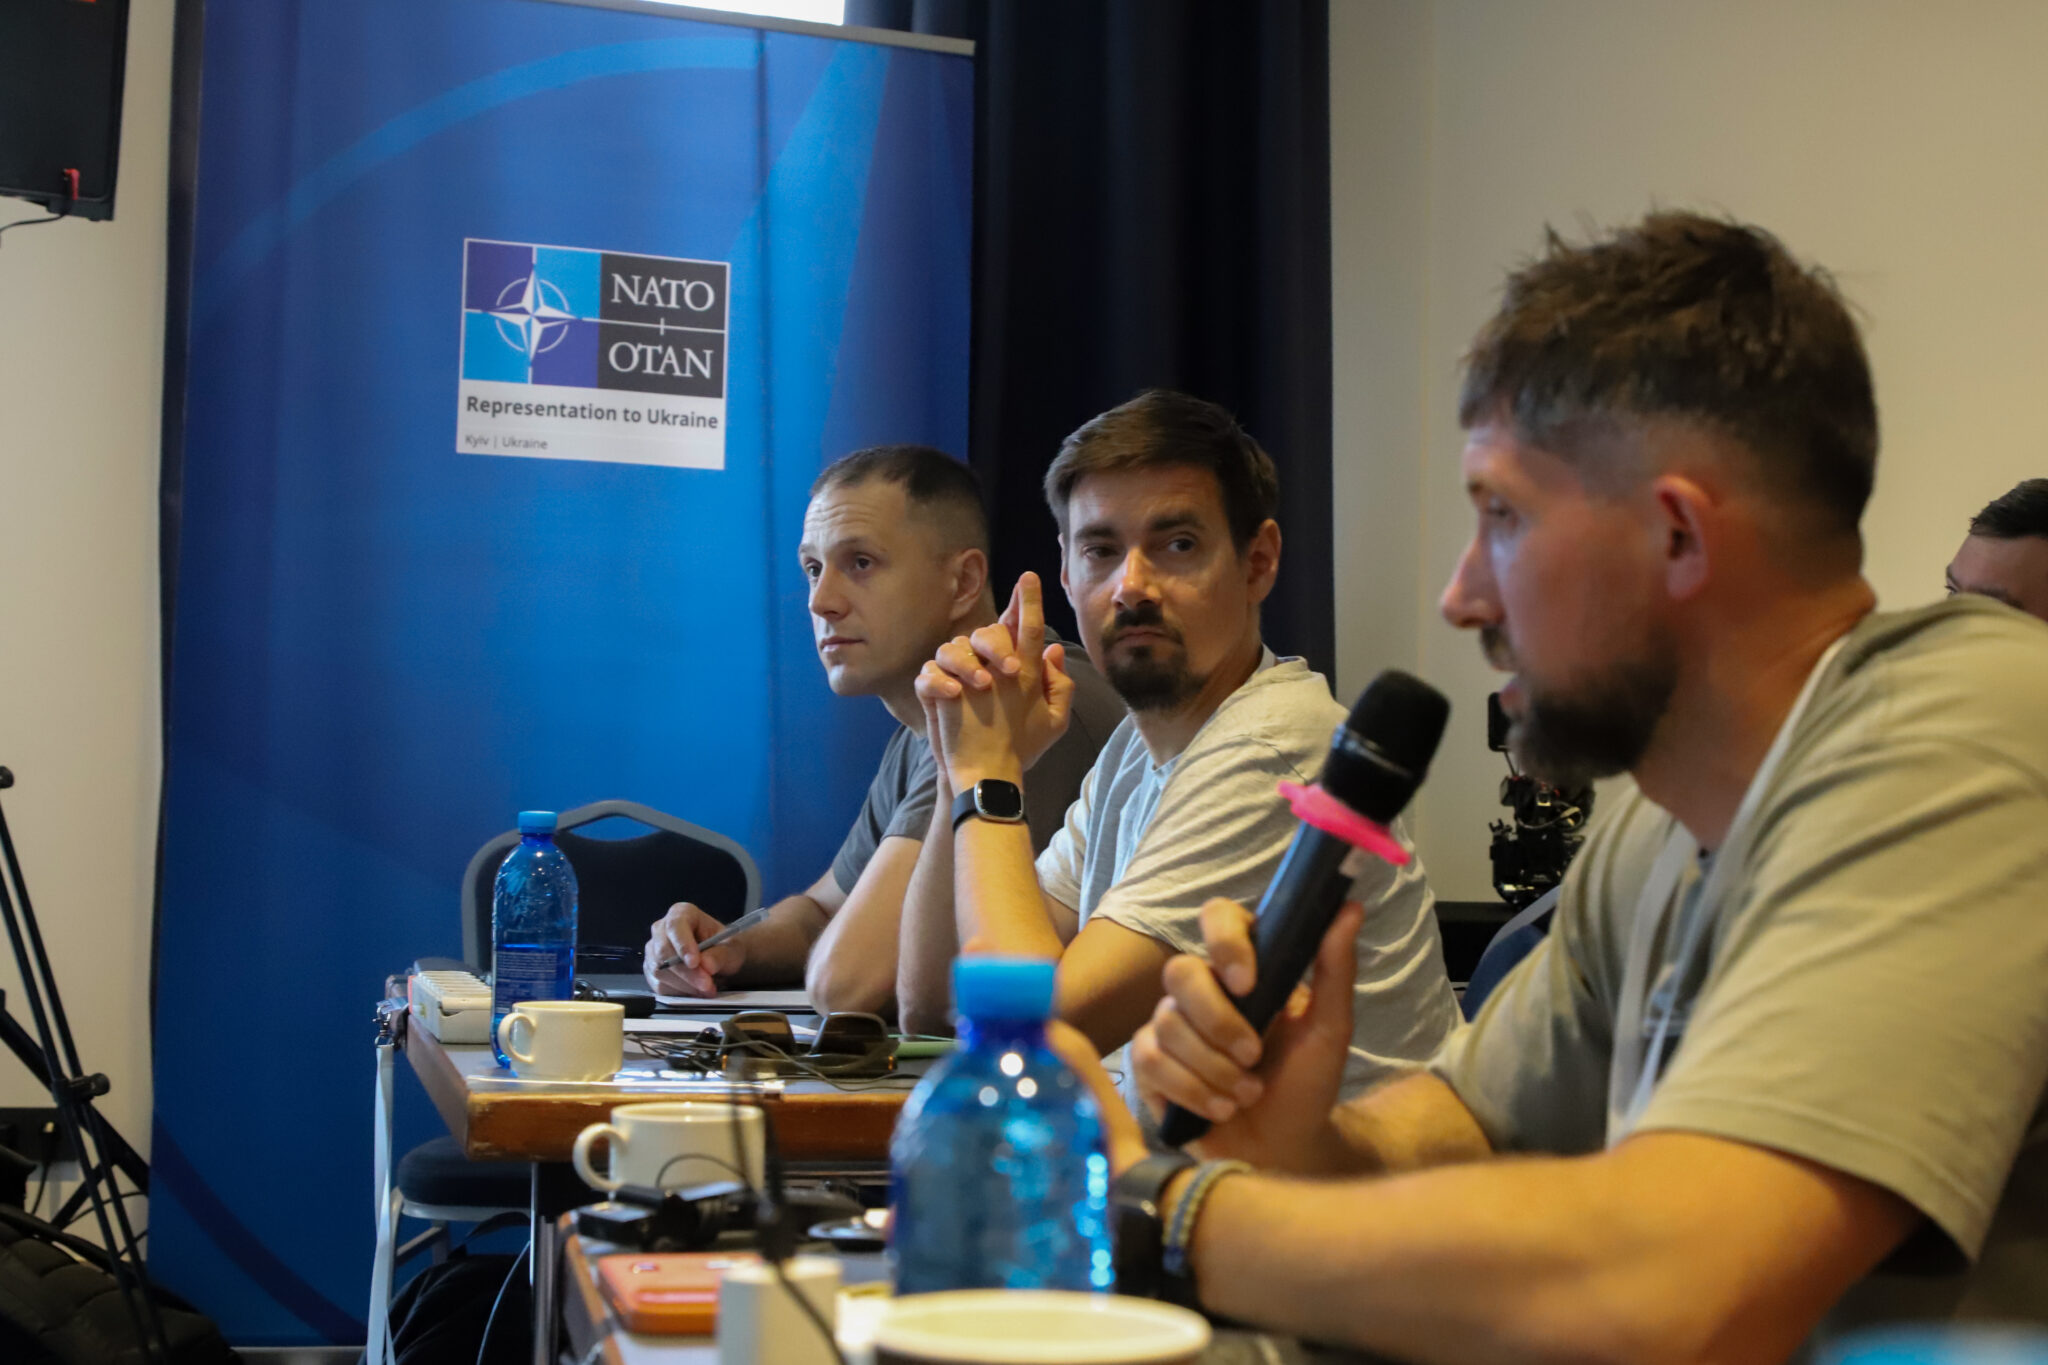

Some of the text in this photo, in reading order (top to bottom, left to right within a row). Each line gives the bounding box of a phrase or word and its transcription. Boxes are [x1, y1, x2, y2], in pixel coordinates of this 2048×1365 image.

[611, 273, 715, 311] NATO
[608, 341, 713, 379] OTAN
[467, 396, 718, 429] Representation to Ukraine
[465, 434, 489, 448] Kyiv
[502, 436, 548, 449] Ukraine
